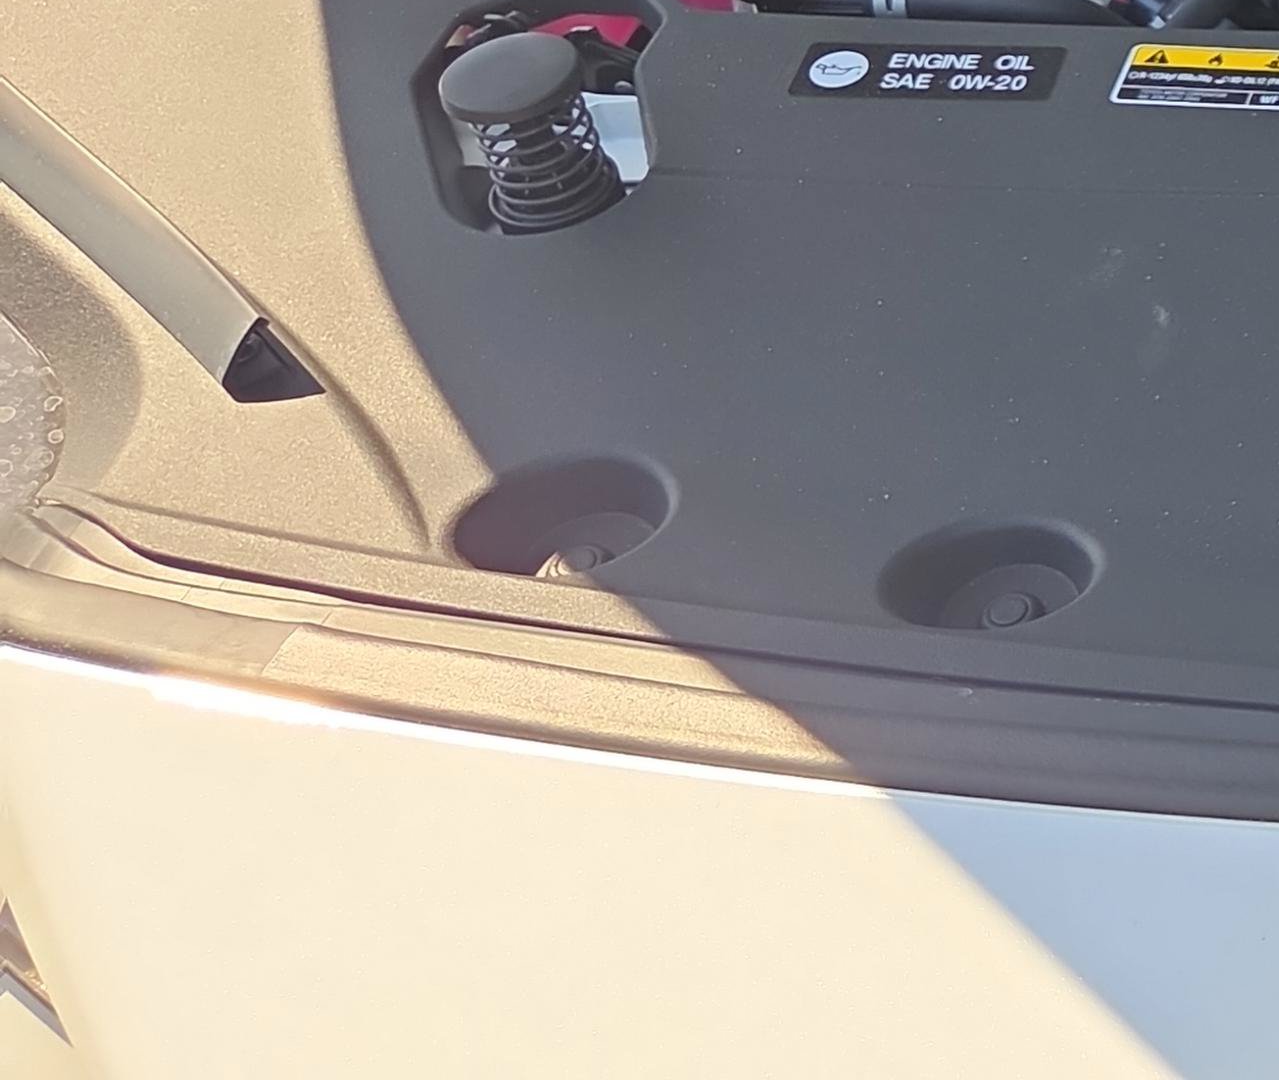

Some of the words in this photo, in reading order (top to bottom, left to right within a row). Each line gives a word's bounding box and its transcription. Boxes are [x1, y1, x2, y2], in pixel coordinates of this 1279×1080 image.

[887, 52, 983, 70] ENGINE
[994, 54, 1035, 71] OIL
[879, 73, 935, 90] SAE
[948, 74, 1028, 92] 0W-20
